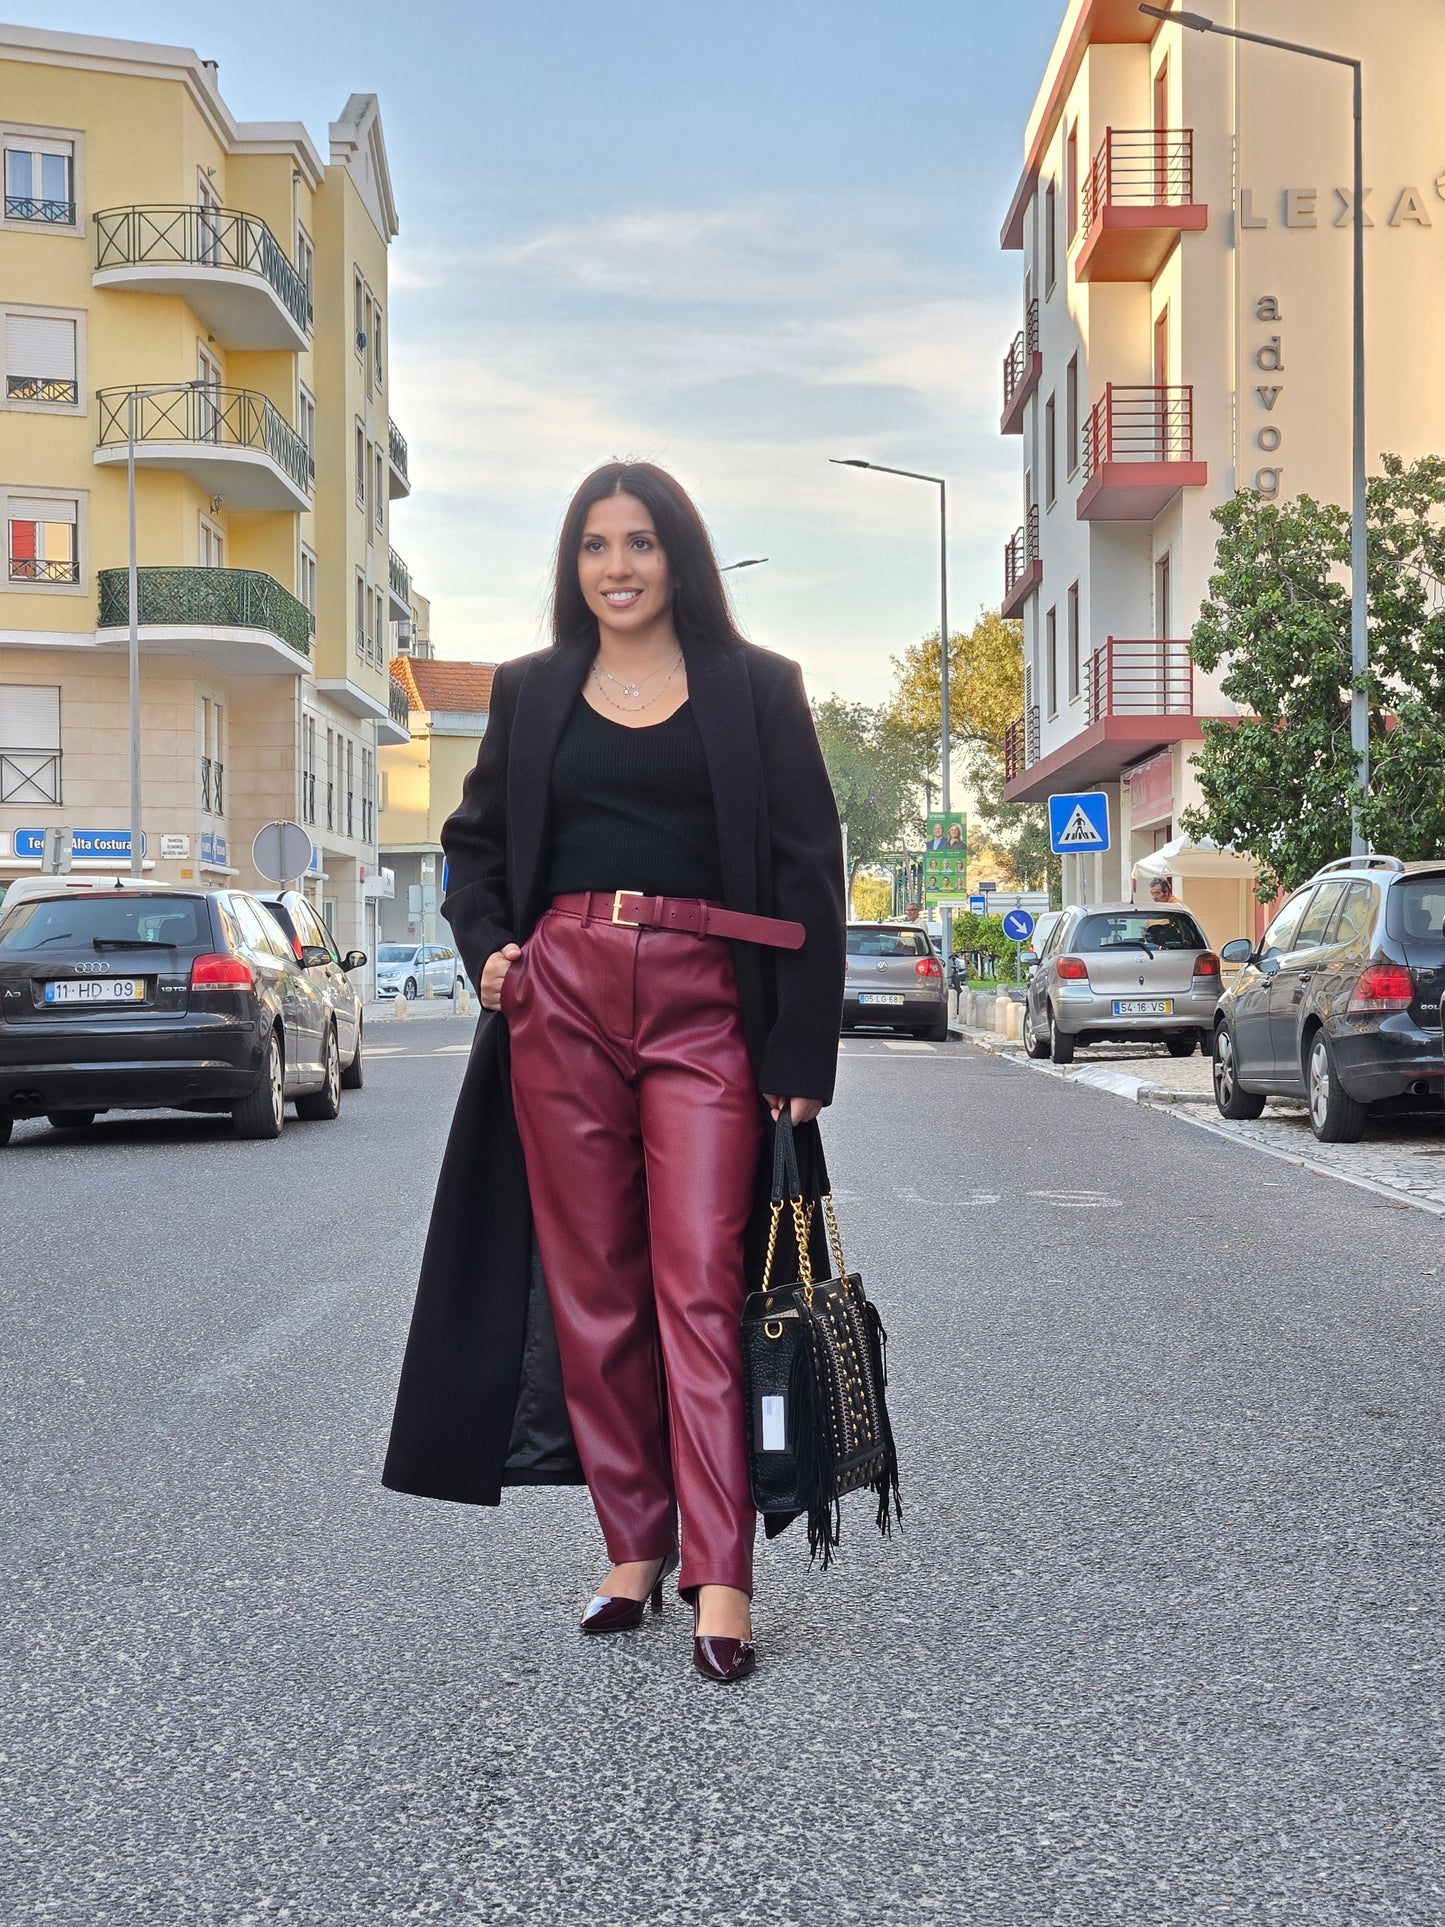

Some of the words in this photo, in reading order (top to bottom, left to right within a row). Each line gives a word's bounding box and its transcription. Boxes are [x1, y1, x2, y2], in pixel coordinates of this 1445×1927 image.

[1255, 295, 1284, 501] advog
[71, 838, 92, 850] Alta
[94, 837, 132, 850] Costura
